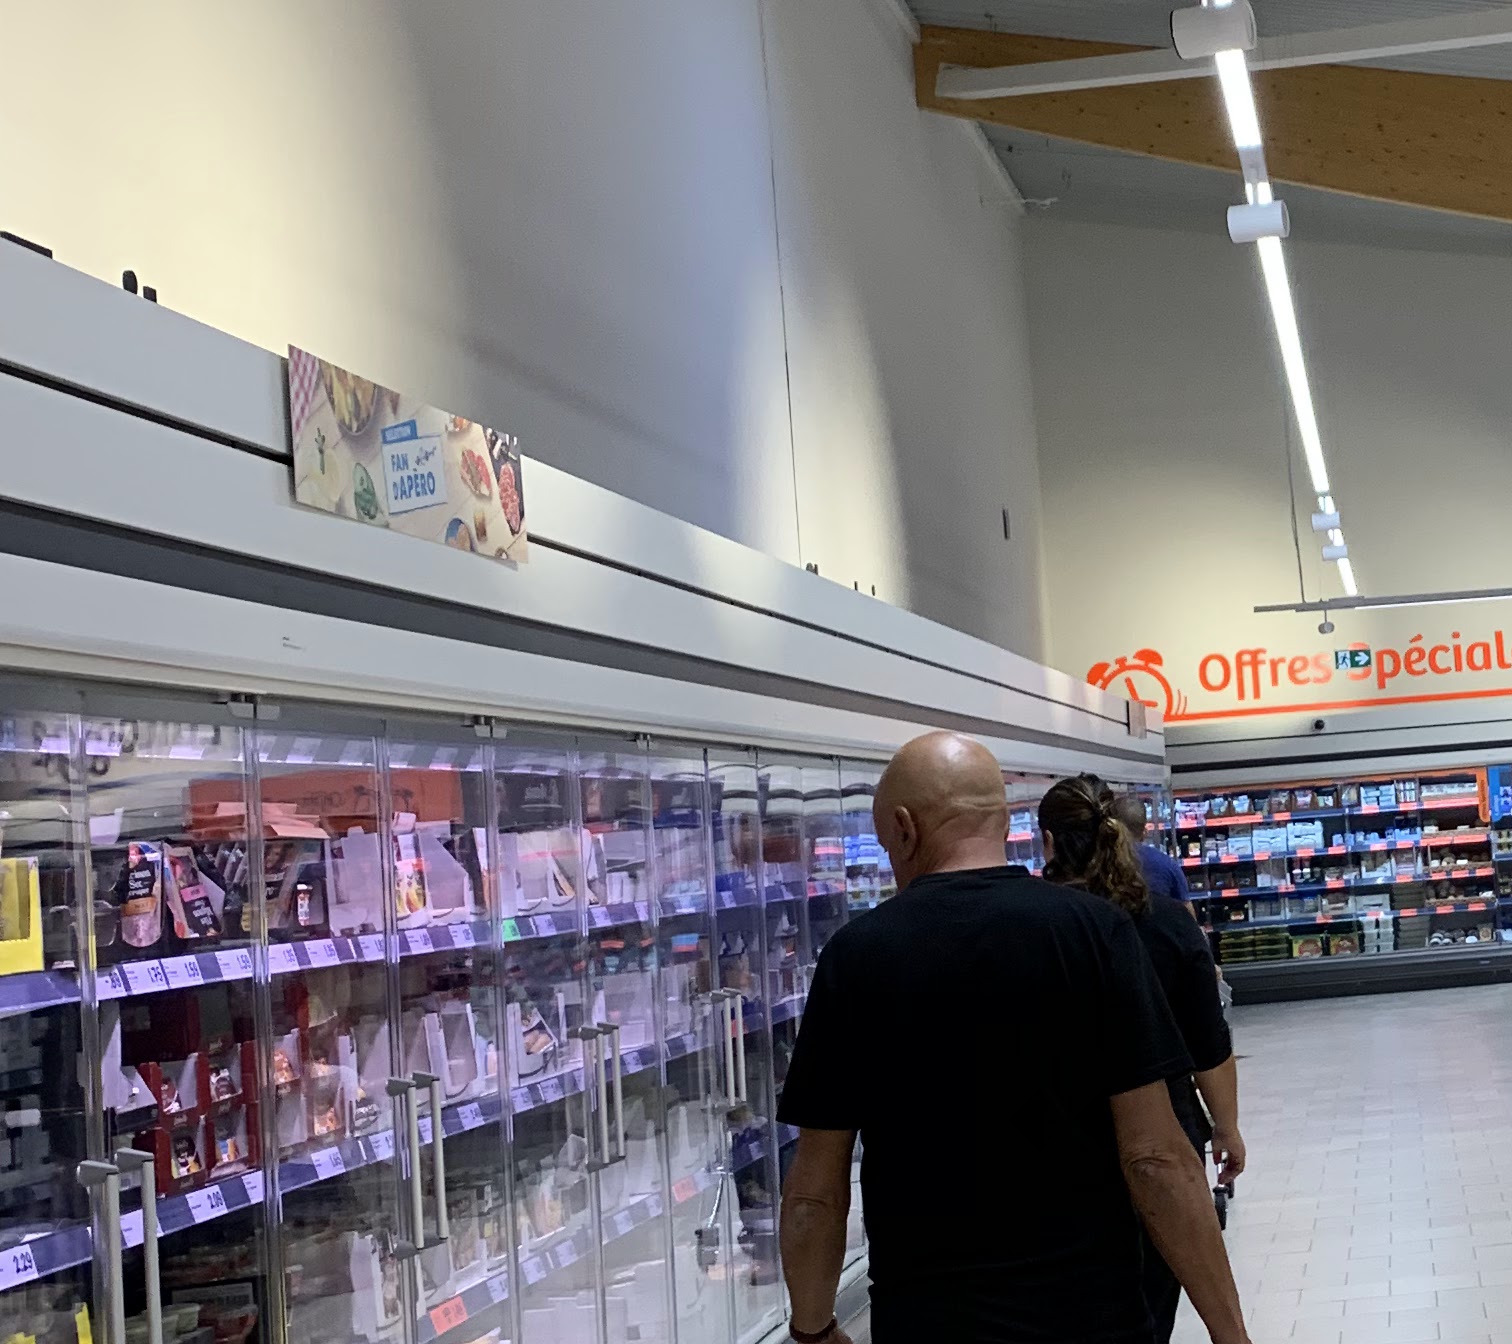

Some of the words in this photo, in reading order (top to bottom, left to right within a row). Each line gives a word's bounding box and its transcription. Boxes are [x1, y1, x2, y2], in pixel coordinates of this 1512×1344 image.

[391, 453, 409, 472] FAN
[1200, 647, 1332, 701] Offres
[12, 1250, 33, 1274] 2.29
